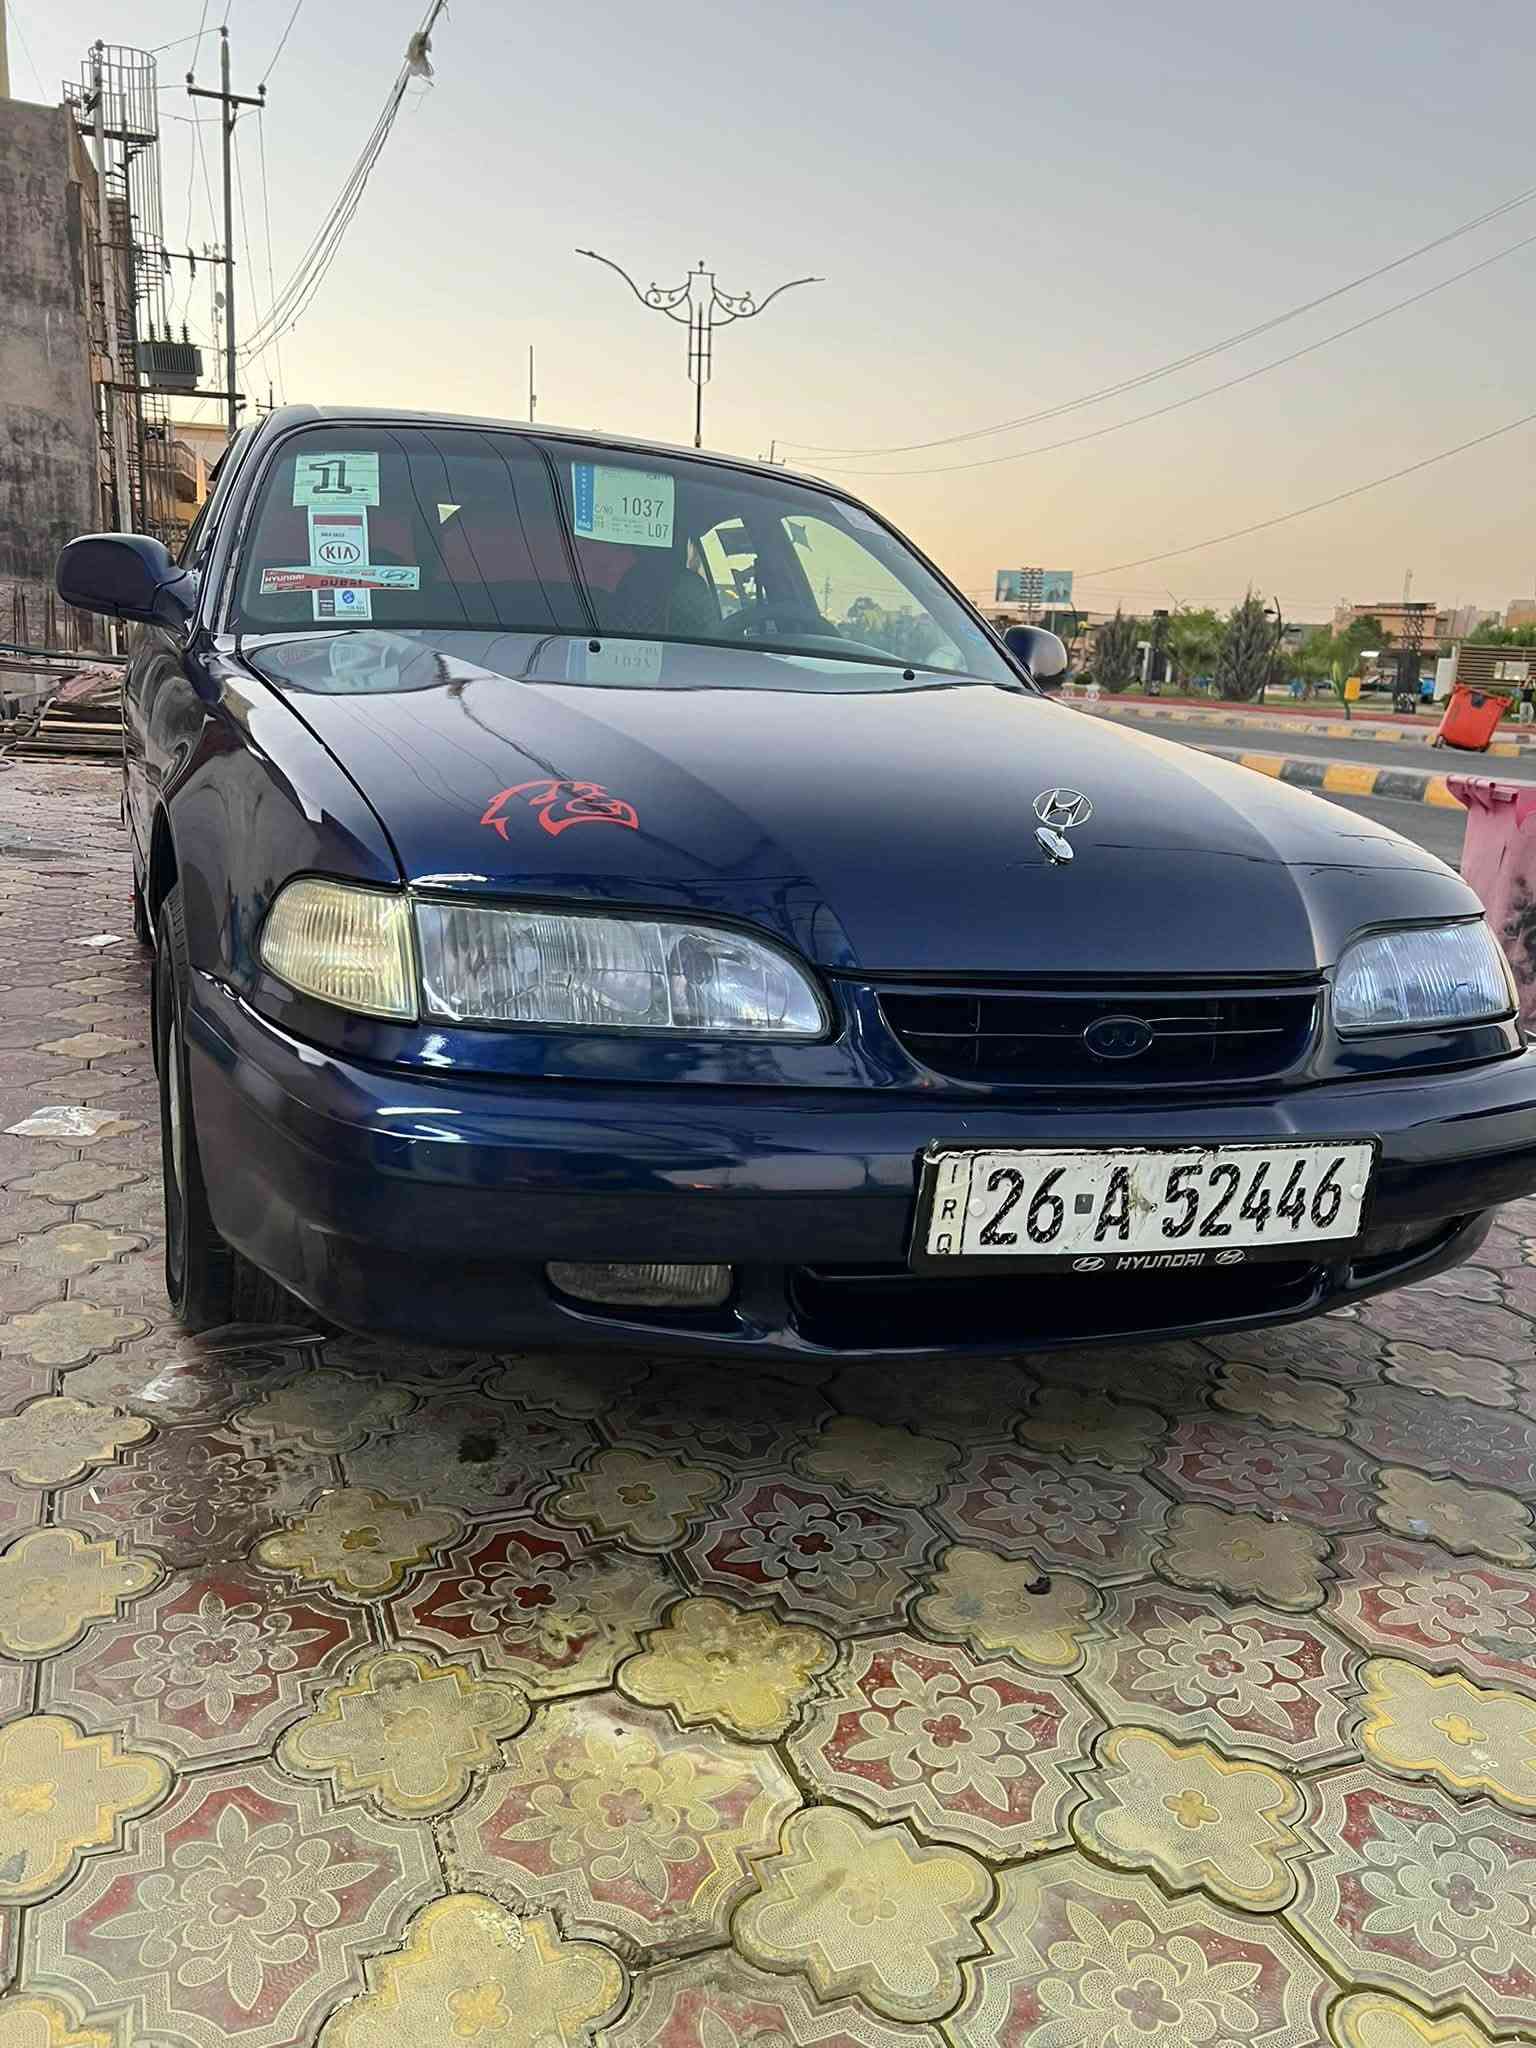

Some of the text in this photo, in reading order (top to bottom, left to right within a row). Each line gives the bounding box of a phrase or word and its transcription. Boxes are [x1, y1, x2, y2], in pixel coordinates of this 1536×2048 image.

[308, 459, 353, 494] 1
[621, 496, 664, 519] 1037
[648, 523, 670, 538] L07
[326, 546, 353, 560] KIA
[264, 573, 305, 583] HYUNDAI
[979, 1157, 1346, 1245] 26 A 52446
[1115, 1251, 1207, 1270] HYUNDAI
